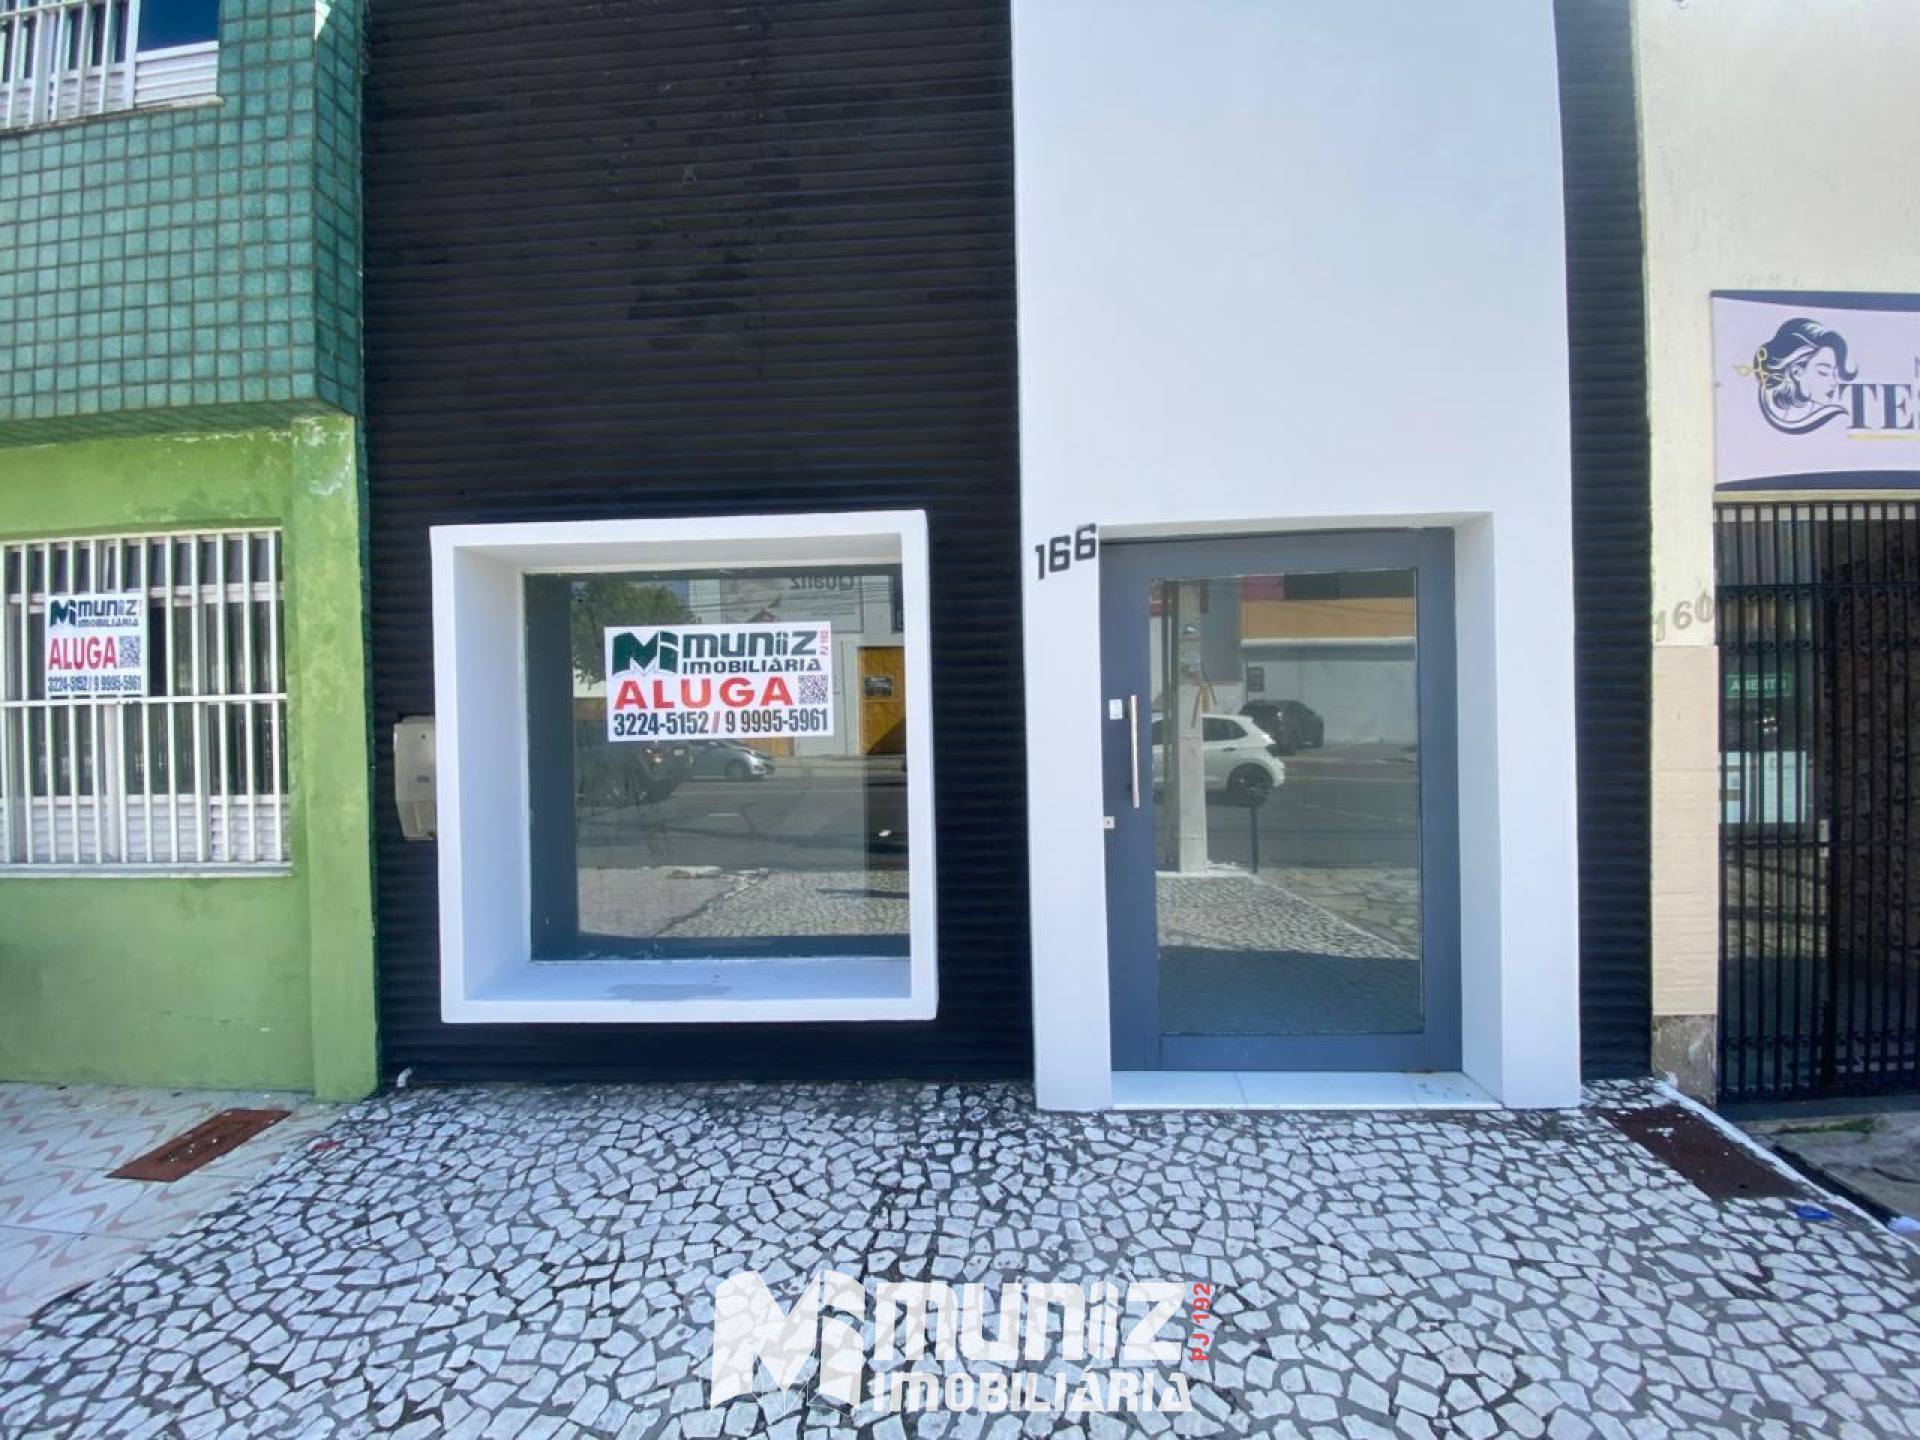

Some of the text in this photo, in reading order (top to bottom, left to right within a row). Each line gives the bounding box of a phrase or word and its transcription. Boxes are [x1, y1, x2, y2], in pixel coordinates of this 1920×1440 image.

[1838, 384, 1920, 429] TE
[1035, 523, 1096, 580] 166
[48, 635, 117, 670] ALUGA
[613, 676, 794, 710] ALUGA
[614, 711, 709, 736] 3224-5152
[725, 710, 736, 733] 9
[741, 708, 828, 733] 9995-5961
